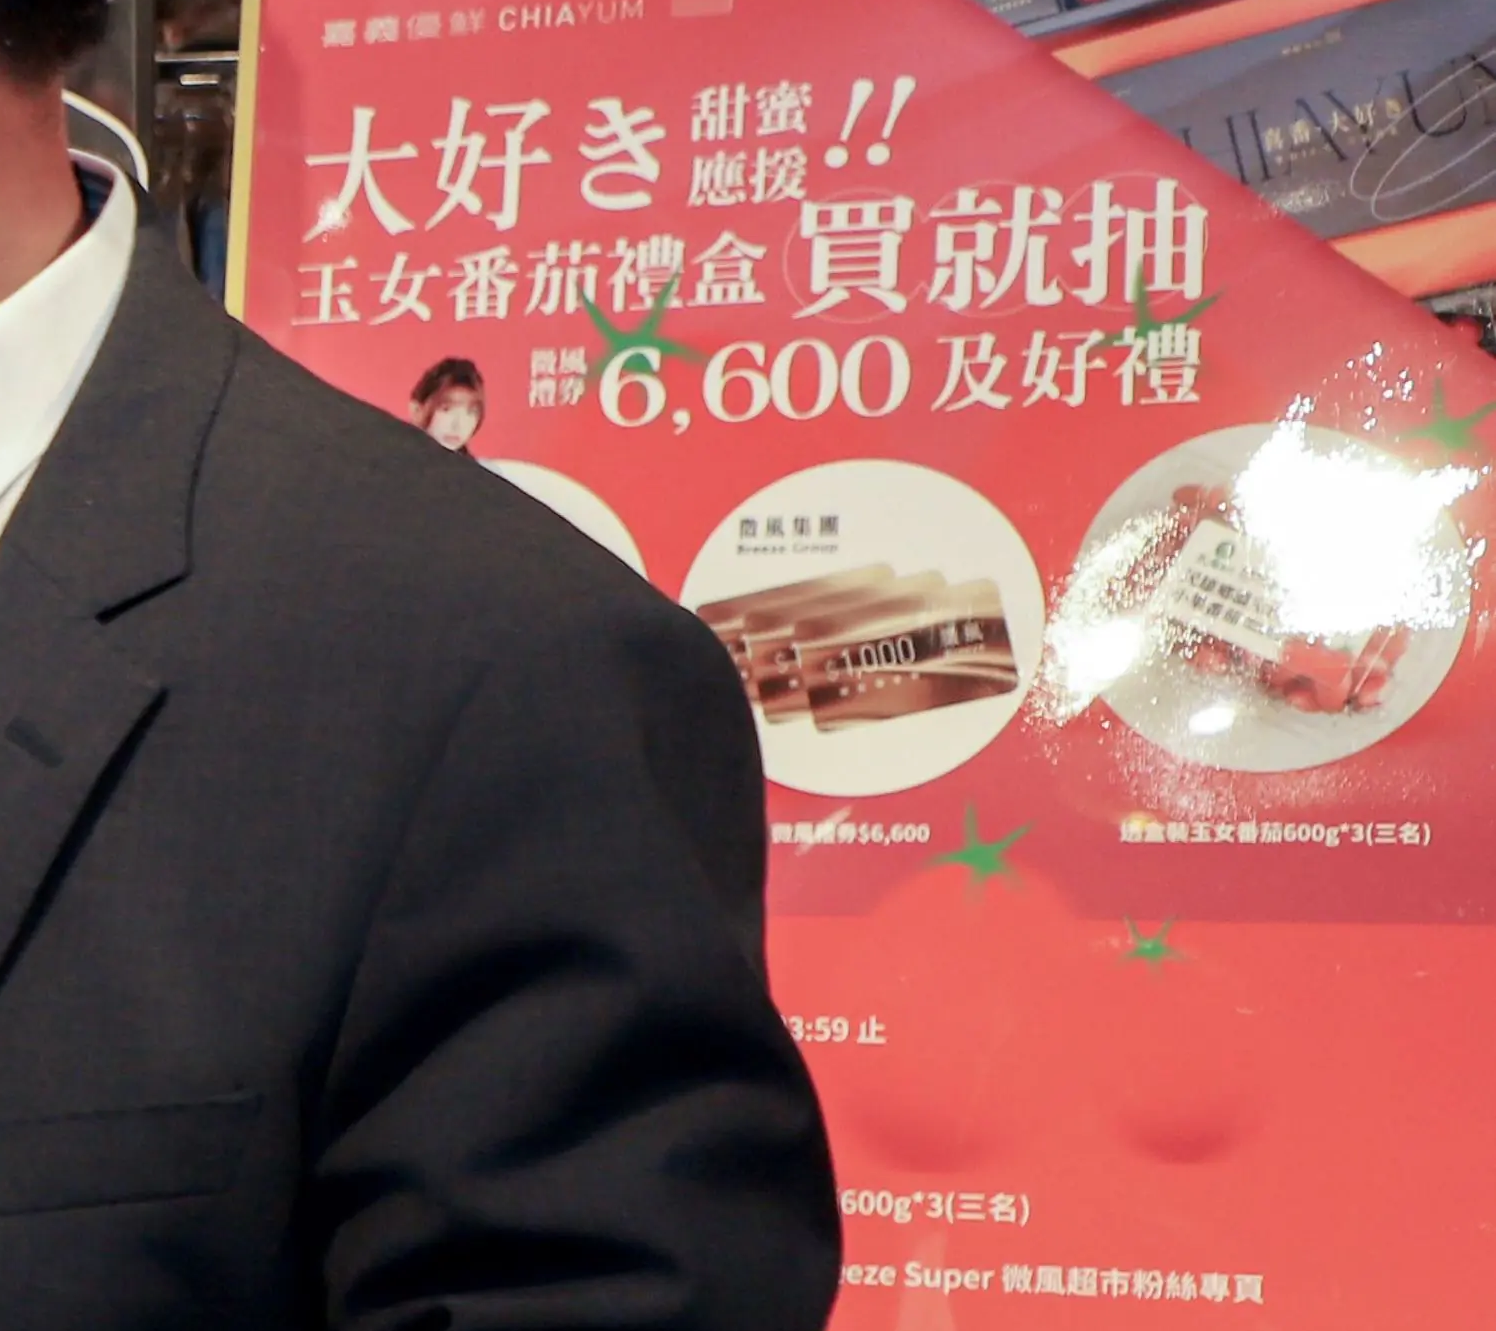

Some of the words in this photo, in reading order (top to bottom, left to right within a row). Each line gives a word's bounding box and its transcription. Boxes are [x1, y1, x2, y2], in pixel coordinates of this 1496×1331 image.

[690, 80, 812, 142] 甜蜜
[303, 95, 666, 243] 大好き
[686, 145, 808, 208] 應援
[291, 229, 768, 326] 玉女番茄禮盒
[793, 178, 1209, 318] 買就抽
[599, 335, 912, 436] 6,600
[930, 323, 1203, 413] 及好禮
[780, 1014, 850, 1043] 3:59
[856, 1015, 887, 1045] 止
[840, 1264, 897, 1286] eze
[904, 1261, 995, 1295] Super
